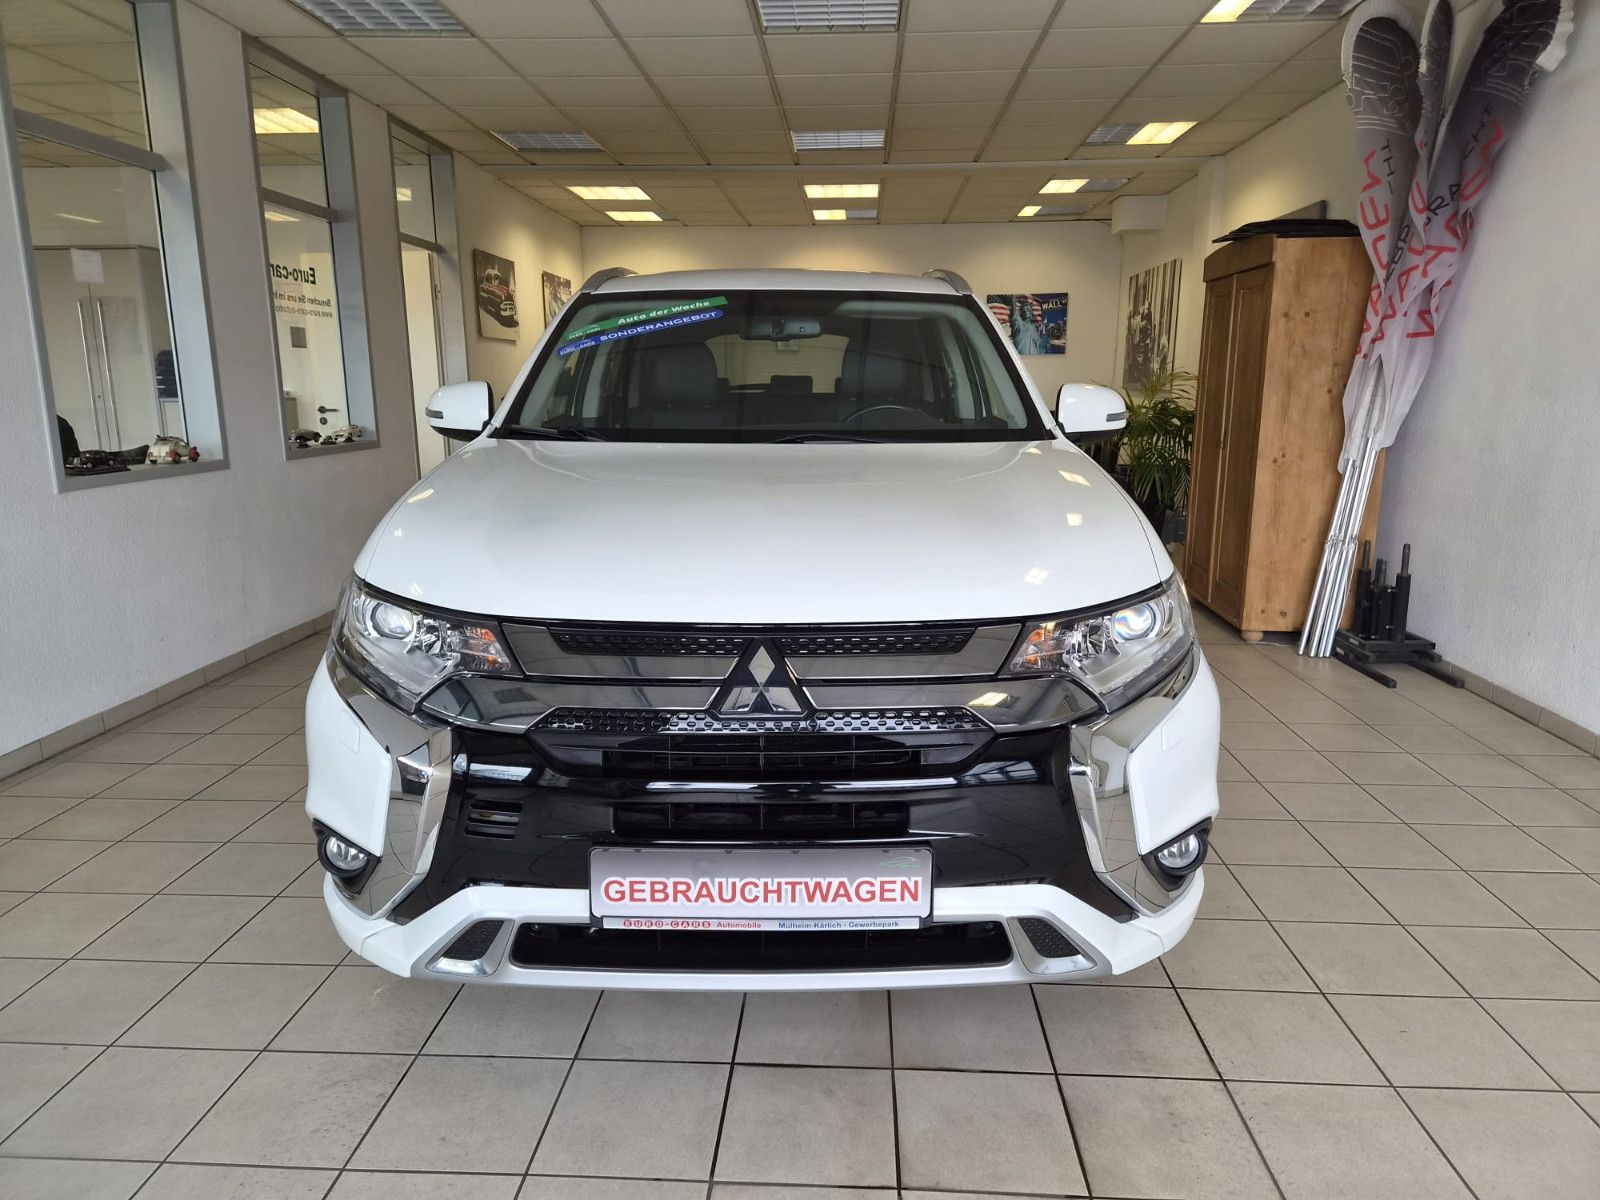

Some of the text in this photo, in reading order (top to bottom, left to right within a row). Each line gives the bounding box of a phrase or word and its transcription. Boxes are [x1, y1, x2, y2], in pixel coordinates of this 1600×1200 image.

[617, 313, 646, 325] Auto
[649, 307, 670, 318] der
[671, 300, 710, 313] Woche
[1041, 298, 1062, 310] WALL
[600, 310, 718, 342] SONDERANGEBOT
[603, 879, 920, 904] GEBRAUCHTWAGEN
[717, 921, 762, 929] Automobile
[848, 921, 899, 929] Gewerbepark
